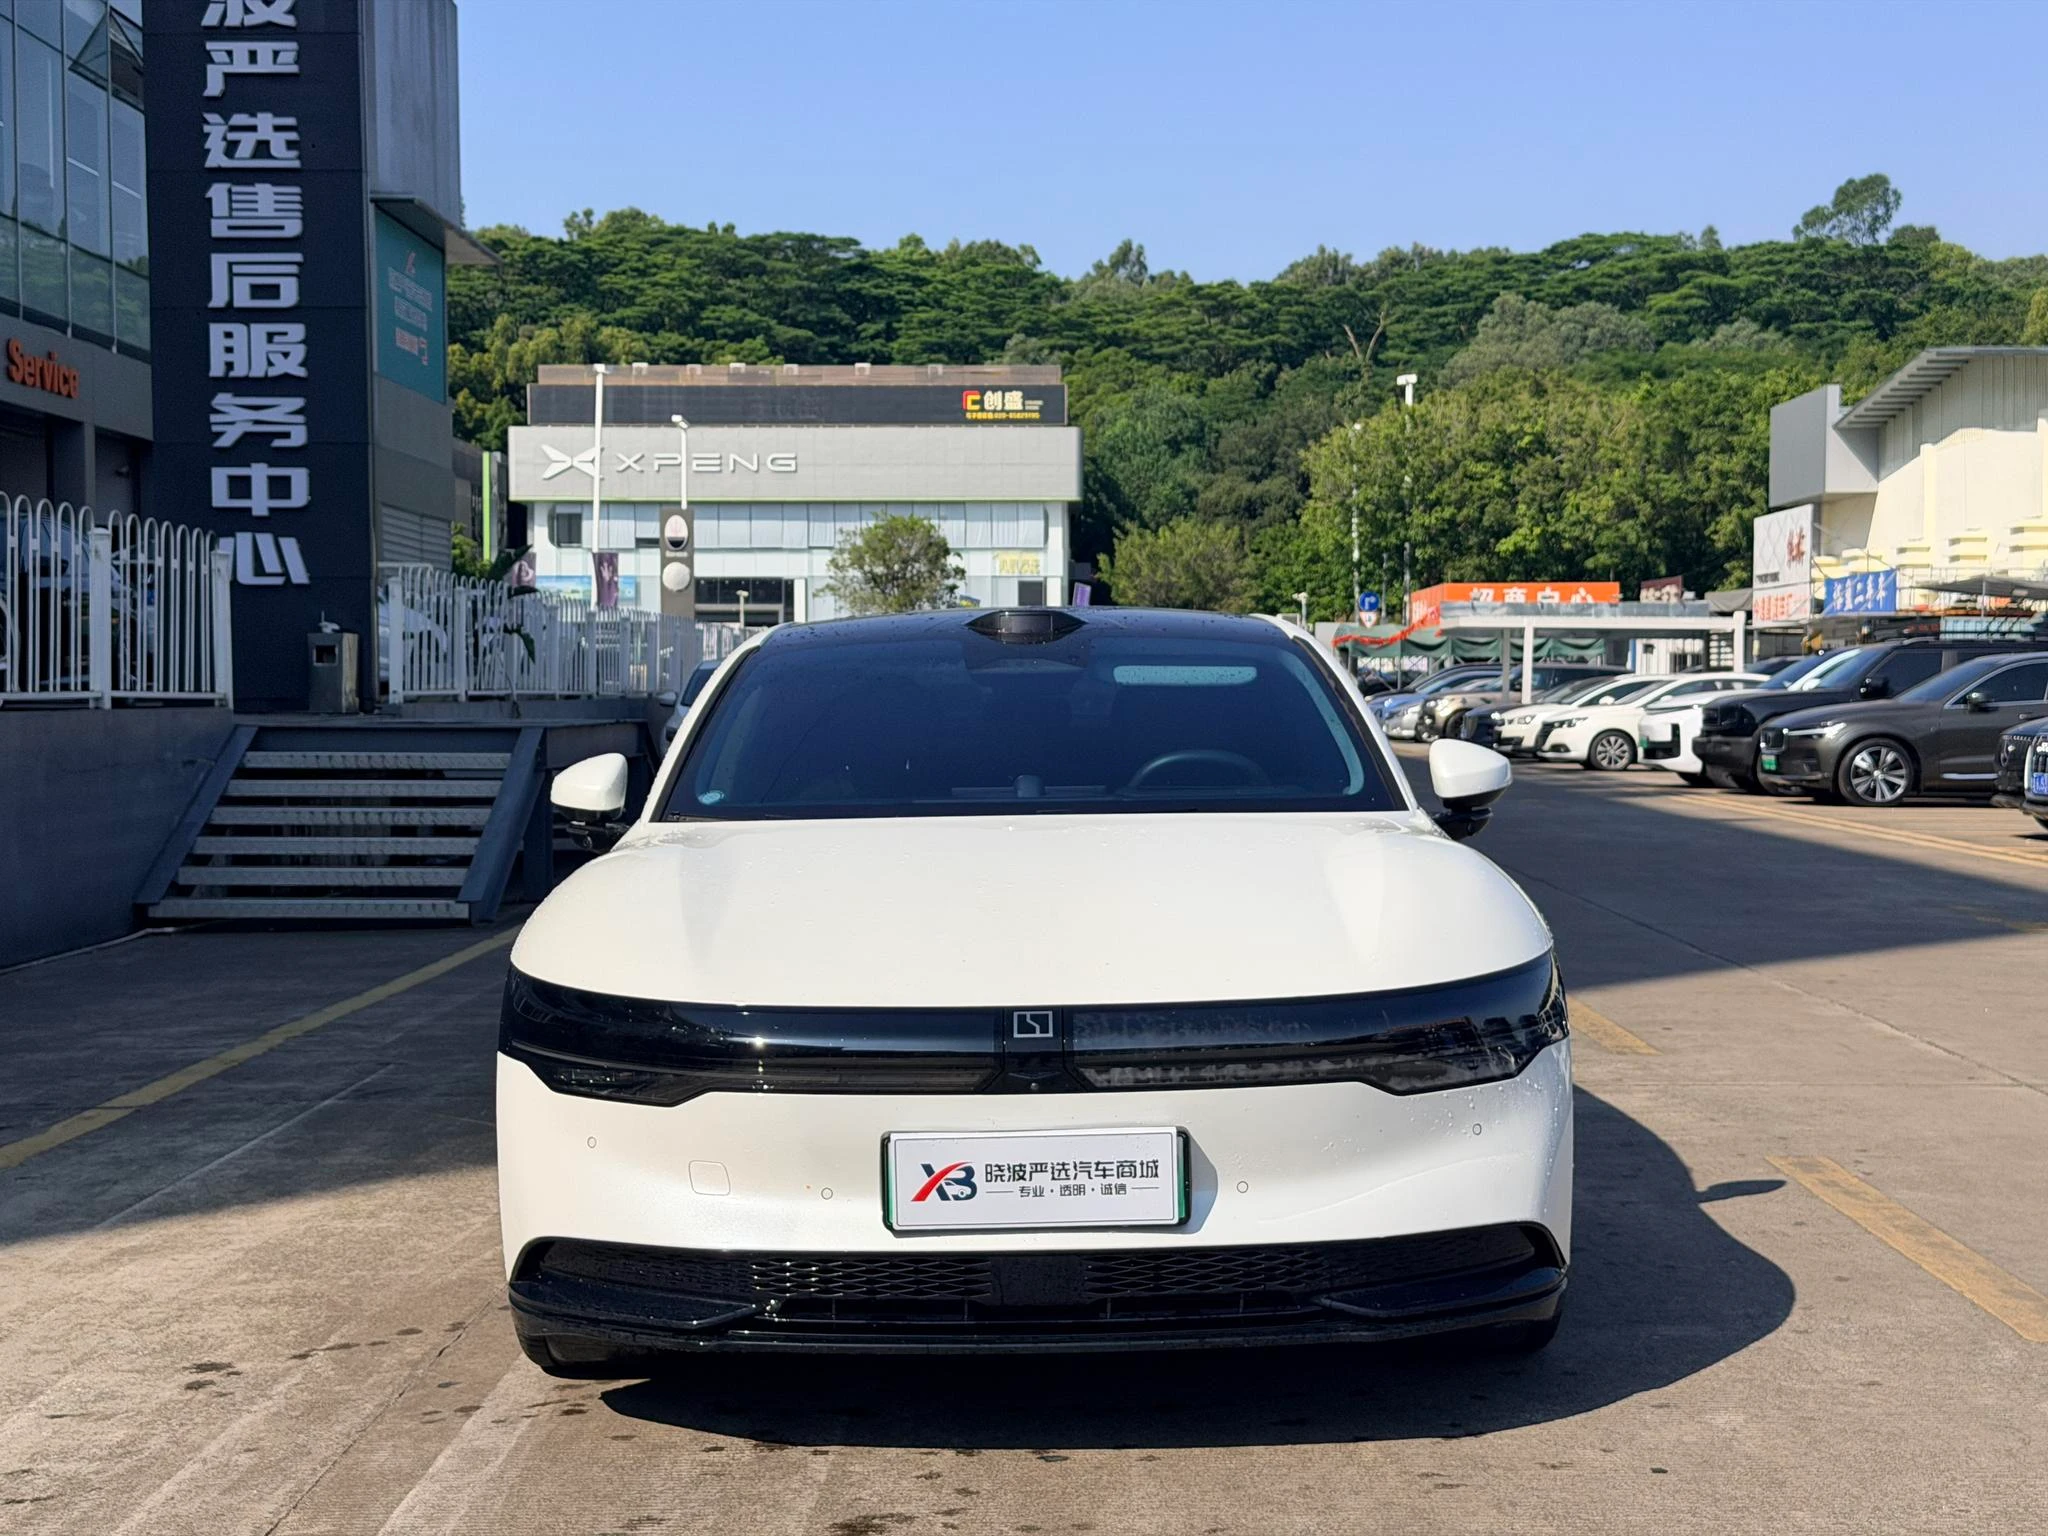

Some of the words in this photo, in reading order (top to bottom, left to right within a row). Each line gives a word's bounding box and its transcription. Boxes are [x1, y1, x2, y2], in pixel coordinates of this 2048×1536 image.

[7, 338, 80, 398] Service
[616, 452, 797, 473] XPENG
[985, 1159, 1159, 1183] 晓波严选汽车商城
